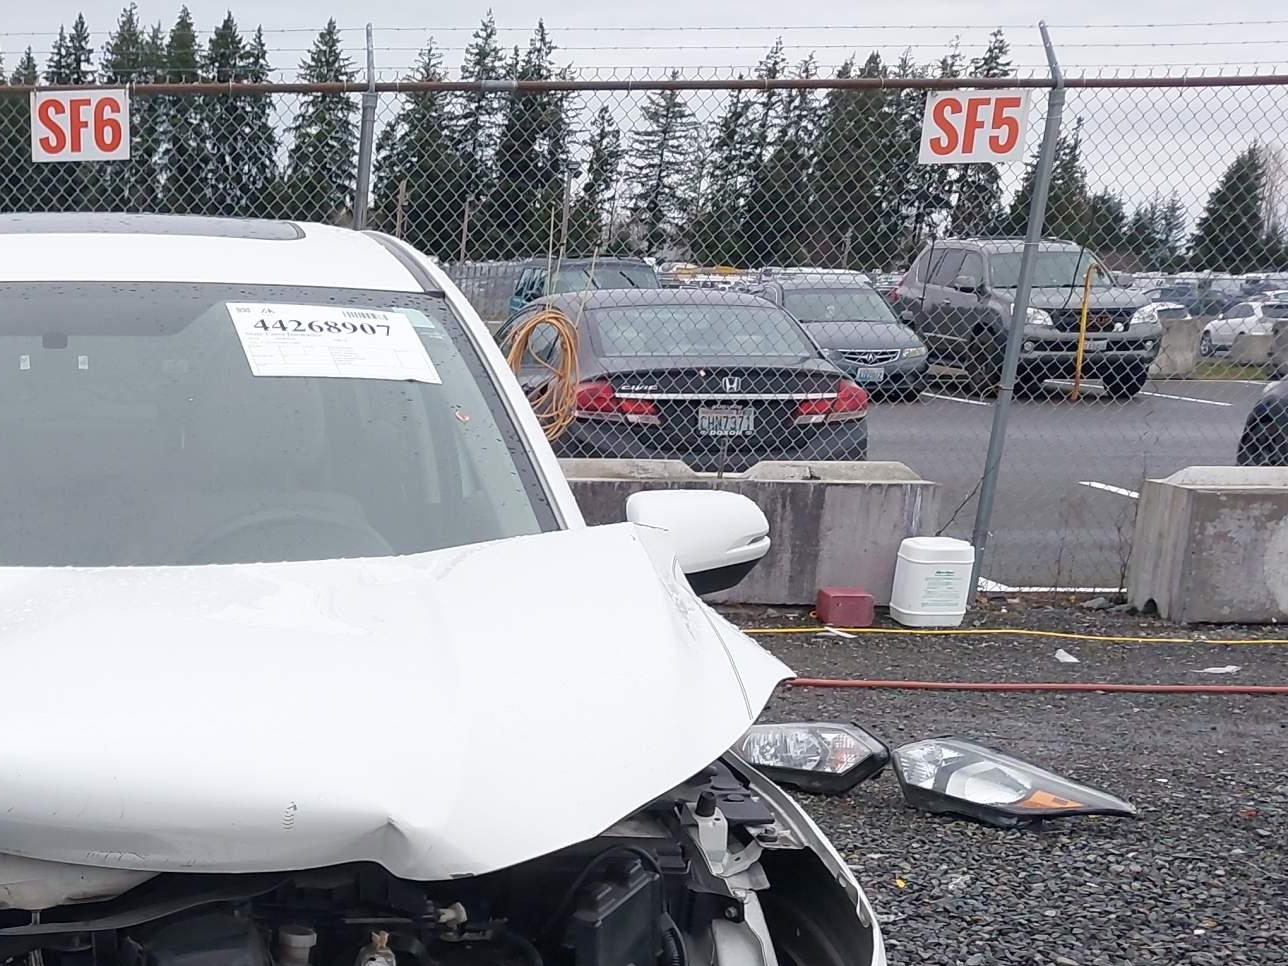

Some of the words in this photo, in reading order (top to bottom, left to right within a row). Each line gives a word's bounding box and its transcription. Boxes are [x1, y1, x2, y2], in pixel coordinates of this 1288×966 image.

[39, 98, 121, 154] SF6
[930, 98, 1021, 155] SF5
[253, 318, 390, 336] 44268907
